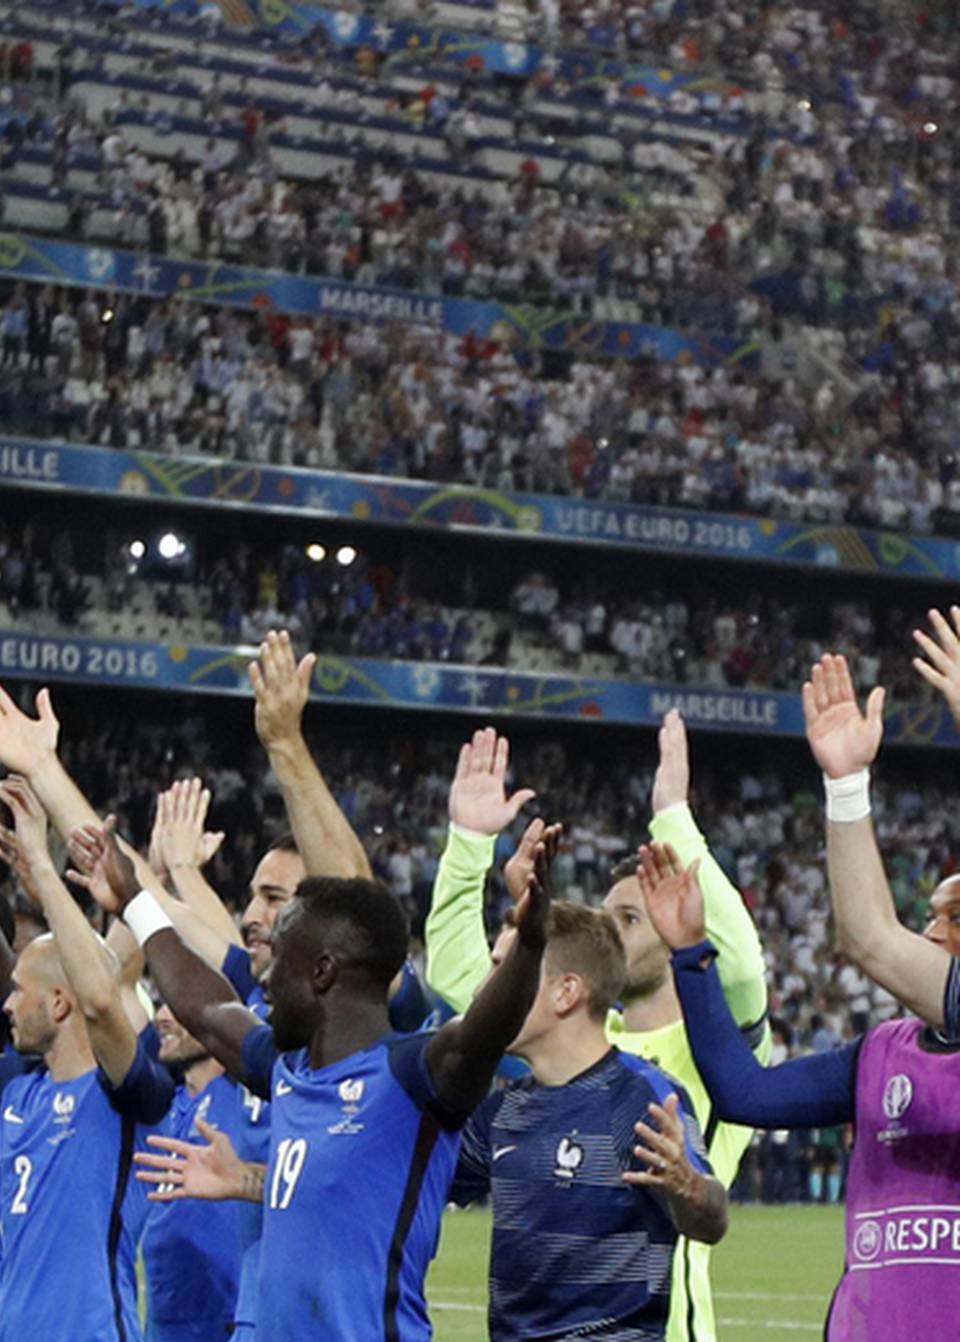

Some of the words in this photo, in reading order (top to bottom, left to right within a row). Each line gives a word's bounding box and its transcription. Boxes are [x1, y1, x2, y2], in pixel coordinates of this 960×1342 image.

[554, 507, 621, 536] UEFA
[624, 513, 689, 543] EURO
[693, 521, 752, 549] 2016
[1, 641, 82, 671] EURO
[87, 648, 157, 677] 2016
[11, 1155, 32, 1214] 2
[270, 1138, 307, 1209] 19
